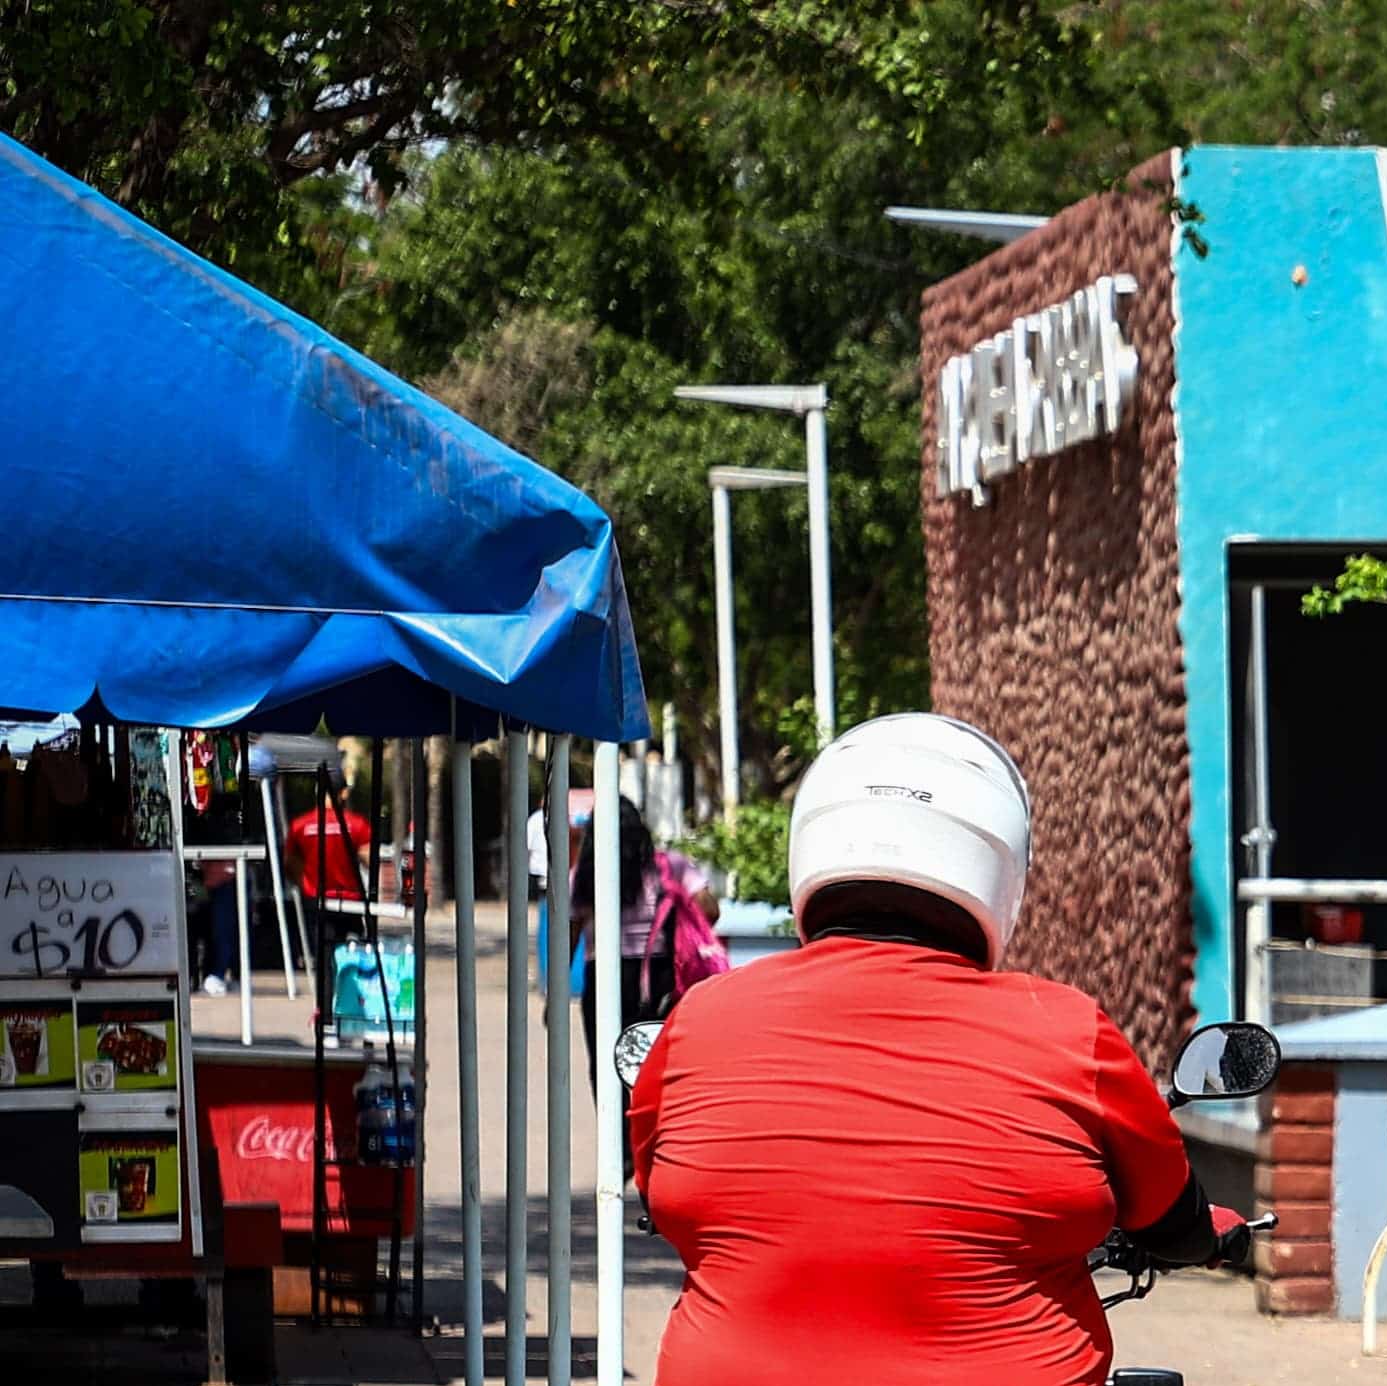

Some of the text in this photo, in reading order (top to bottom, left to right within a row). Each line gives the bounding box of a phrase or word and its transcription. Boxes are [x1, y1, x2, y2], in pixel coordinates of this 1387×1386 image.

[4, 866, 115, 912] Agua
[57, 909, 75, 928] a
[11, 908, 145, 977] $10
